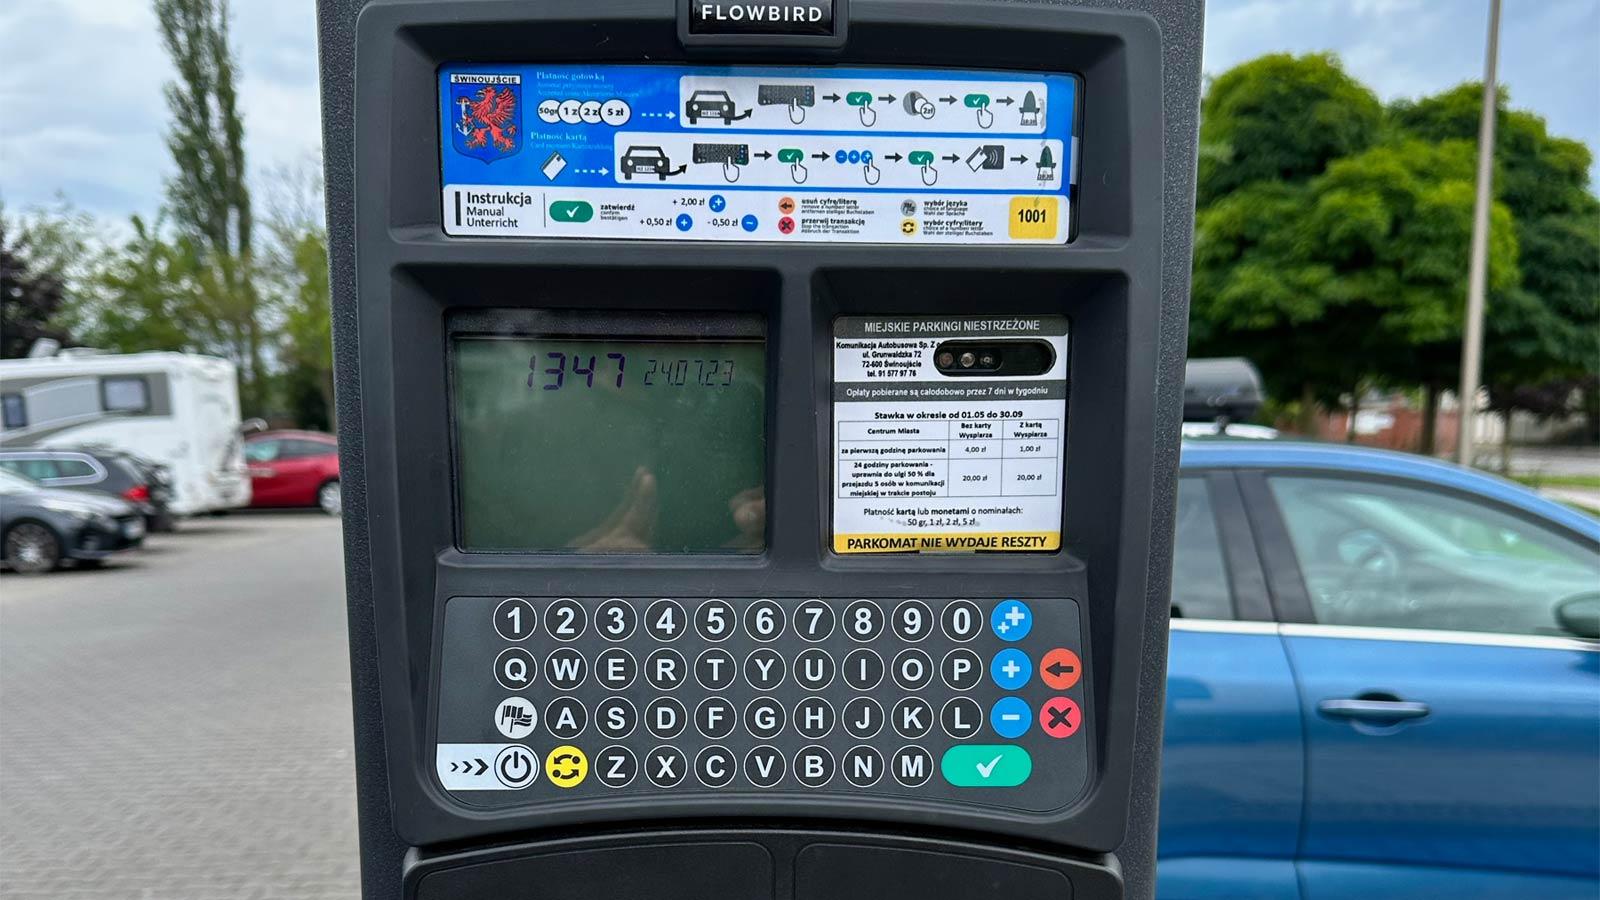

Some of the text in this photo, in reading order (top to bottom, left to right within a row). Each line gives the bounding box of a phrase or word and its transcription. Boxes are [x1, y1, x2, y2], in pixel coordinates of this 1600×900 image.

[702, 4, 822, 22] FLOWBIRD
[454, 74, 517, 84] ŚWINOUJŚCIE
[607, 107, 624, 117] 5 zł
[467, 191, 532, 208] Instrukcja
[681, 197, 705, 206] 2,00 zł
[924, 199, 967, 208] wybór języka
[467, 206, 505, 216] Manual
[600, 203, 635, 212] zatwierdź
[1018, 209, 1046, 223] 1001
[467, 218, 519, 228] Unterricht
[647, 217, 672, 226] 0,50 zł
[713, 218, 738, 227] 0,50 zł
[865, 317, 1040, 332] MIEJSKIE PARKINGI NIESTRZEŻONE
[836, 342, 876, 351] Komunikacja
[878, 341, 917, 350] Autobusowa
[919, 341, 929, 350] Sp.
[872, 351, 912, 359] Grunwaldzka
[862, 360, 922, 370] 72-600 Świnoujście
[846, 388, 870, 398] Opłaty
[871, 388, 908, 398] pobierane
[910, 388, 919, 398] są
[920, 387, 965, 396] całodobowo
[966, 388, 987, 397] przez
[988, 387, 992, 395] 7
[994, 387, 1006, 395] dni
[1016, 386, 1048, 397] tygodniu
[874, 411, 905, 419] Stawka
[916, 411, 946, 419] okresie
[948, 411, 959, 419] od
[961, 411, 985, 419] 01.05
[1000, 410, 1023, 418] 30.09
[974, 422, 992, 431] karty
[1025, 421, 1042, 430] kartą
[898, 427, 920, 435] Miasta
[959, 431, 993, 439] Wyspiarza
[1014, 431, 1047, 439] Wyspiarza
[850, 447, 879, 456] pierwszą
[880, 447, 906, 456] godzinę
[908, 446, 946, 455] parkowania
[965, 446, 980, 454] 4,00
[1019, 445, 1033, 453] 1,00
[864, 462, 889, 470] godziny
[891, 461, 929, 470] parkowania
[852, 470, 882, 479] uprawnia
[884, 470, 892, 478] do
[894, 470, 907, 479] ulgi
[908, 470, 916, 478] 50
[925, 469, 935, 477] dla
[963, 474, 988, 483] 20,00 zł
[1017, 473, 1042, 482] 20,00 zł
[842, 480, 873, 489] przejazdu
[880, 479, 897, 487] osób
[906, 479, 945, 488] komunikacji
[850, 489, 879, 498] miejskiej
[888, 489, 910, 497] trakcie
[911, 488, 936, 498] postoju
[864, 507, 894, 517] Płatność
[896, 507, 916, 517] kartą
[918, 507, 929, 516] lub
[931, 507, 969, 516] monetami
[978, 506, 1023, 515] nominałach:
[908, 517, 975, 528] 50 gr, 1 zł, 2 zł, 5 zł
[847, 536, 1047, 549] PARKOMAT NIE WYDAJE RESZTY
[508, 607, 970, 634] 1 2 3 4 5 6 7 8 9 0
[505, 658, 970, 682] Q W E R T Y U I O P
[556, 707, 970, 729] A S D F G H J K L
[607, 755, 923, 778] Z X C V B N M
